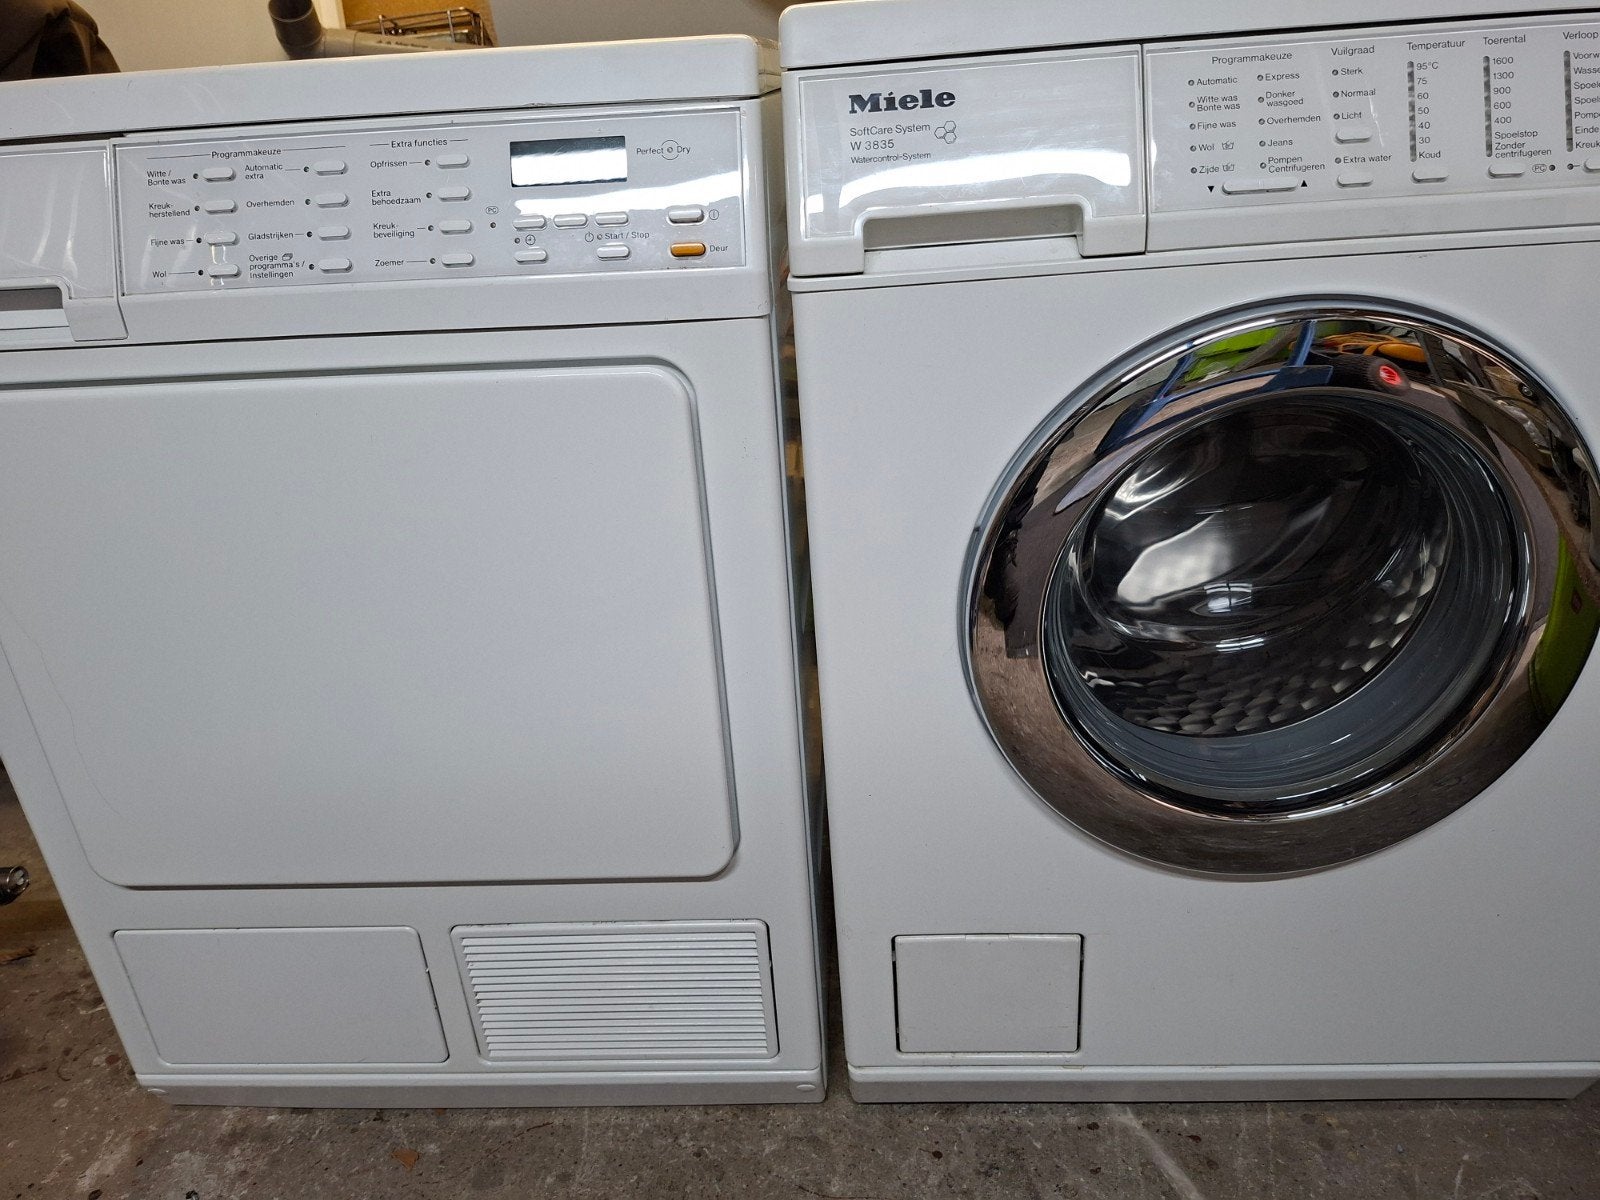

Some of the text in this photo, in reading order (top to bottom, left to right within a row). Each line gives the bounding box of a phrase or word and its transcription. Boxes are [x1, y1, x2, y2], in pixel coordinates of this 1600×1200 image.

[1483, 34, 1526, 46] Toerental
[1562, 31, 1599, 40] Verloop
[1407, 40, 1466, 51] Temperatuur
[1331, 45, 1375, 56] Vuilgraad
[1212, 52, 1293, 66] Programmakeuze
[1493, 57, 1514, 65] 1600
[1416, 61, 1439, 70] 95°C
[1340, 67, 1363, 75] Sterk
[1493, 71, 1514, 80] 1300
[1196, 77, 1238, 86] Automatic
[1265, 73, 1300, 82] Express
[1417, 77, 1427, 85] 75
[1266, 90, 1296, 99] Donker
[1341, 88, 1376, 98] Normaal
[1493, 86, 1511, 94] 900
[848, 89, 956, 114] Miele
[1197, 96, 1220, 104] Witte
[1267, 98, 1304, 107] wasgoed
[1197, 104, 1222, 112] Bonte
[1493, 101, 1512, 109] 600
[1267, 115, 1321, 125] Overhemden
[1341, 111, 1362, 120] Licht
[1494, 116, 1512, 124] 400
[1197, 122, 1217, 131] Fijne
[1418, 121, 1431, 129] 40
[849, 124, 931, 137] SoftCare System
[1494, 130, 1538, 140] Spoelstop
[1575, 126, 1600, 135] Einde
[391, 138, 448, 149] Extra functies
[1268, 139, 1293, 147] Jeans
[1418, 136, 1431, 144] 30
[850, 139, 895, 151] W 3835
[1198, 143, 1215, 151] Wol
[1495, 142, 1526, 151] Zonder
[211, 148, 282, 160] Programmakeuze
[636, 145, 691, 155] Perfect Dry
[1495, 149, 1552, 159] centrifugeren
[850, 152, 931, 164] Watercontrol-System
[1343, 153, 1392, 164] Extra water
[1418, 151, 1441, 159] Koud
[370, 160, 408, 168] Opfrissen
[1268, 156, 1303, 165] Pompen
[245, 163, 283, 172] Automatic
[1199, 165, 1220, 174] Zijde
[1268, 163, 1325, 173] Centrifugeren
[147, 170, 166, 178] Witte
[245, 172, 264, 180] extra
[147, 178, 170, 186] Bonte
[371, 190, 391, 198] Extra
[149, 202, 174, 210] Kreuk-
[246, 199, 295, 208] Overhemden
[372, 197, 422, 206] behoedzaam
[149, 209, 190, 218] herstellend
[248, 231, 294, 241] Gladstrijken
[373, 230, 415, 239] beveiliging
[605, 232, 624, 240] Start
[631, 231, 650, 241] Stop
[150, 238, 170, 247] Fijne
[709, 245, 728, 253] Deur
[249, 254, 278, 262] Overige
[250, 261, 300, 271] programma's
[375, 259, 405, 267] Zoemer
